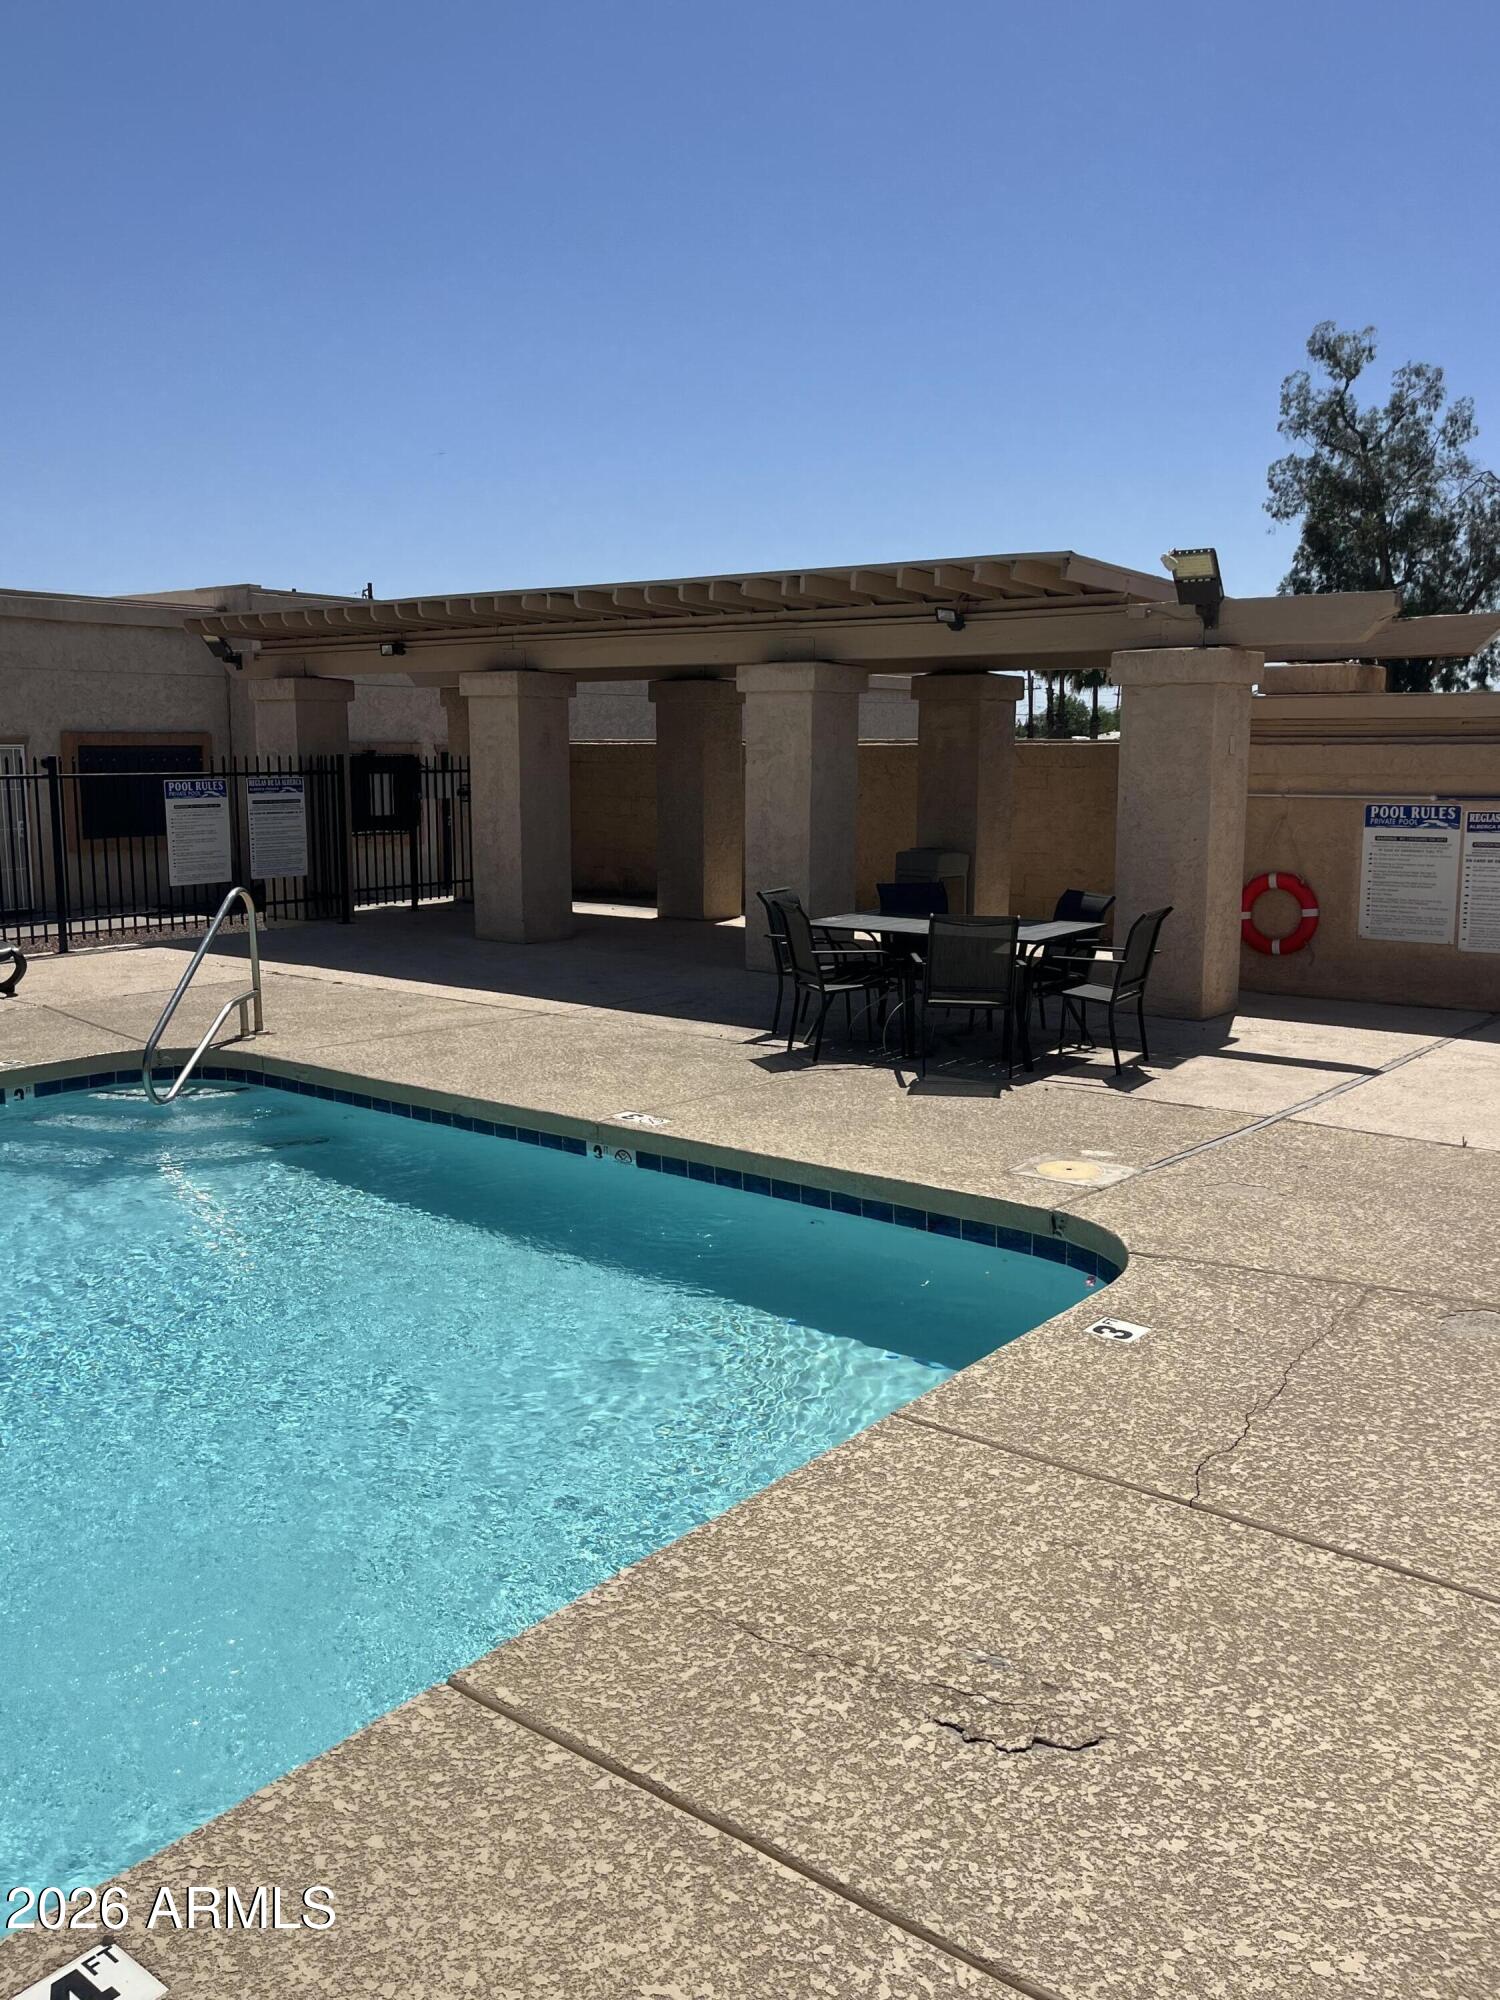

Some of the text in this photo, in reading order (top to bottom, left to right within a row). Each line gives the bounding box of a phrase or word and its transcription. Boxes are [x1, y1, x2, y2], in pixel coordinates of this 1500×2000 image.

[168, 781, 224, 792] POOL RULES
[1370, 806, 1456, 819] POOL RULES
[1469, 813, 1500, 822] REGLAS
[1092, 1325, 1133, 1340] 3
[81, 1945, 119, 1976] FT
